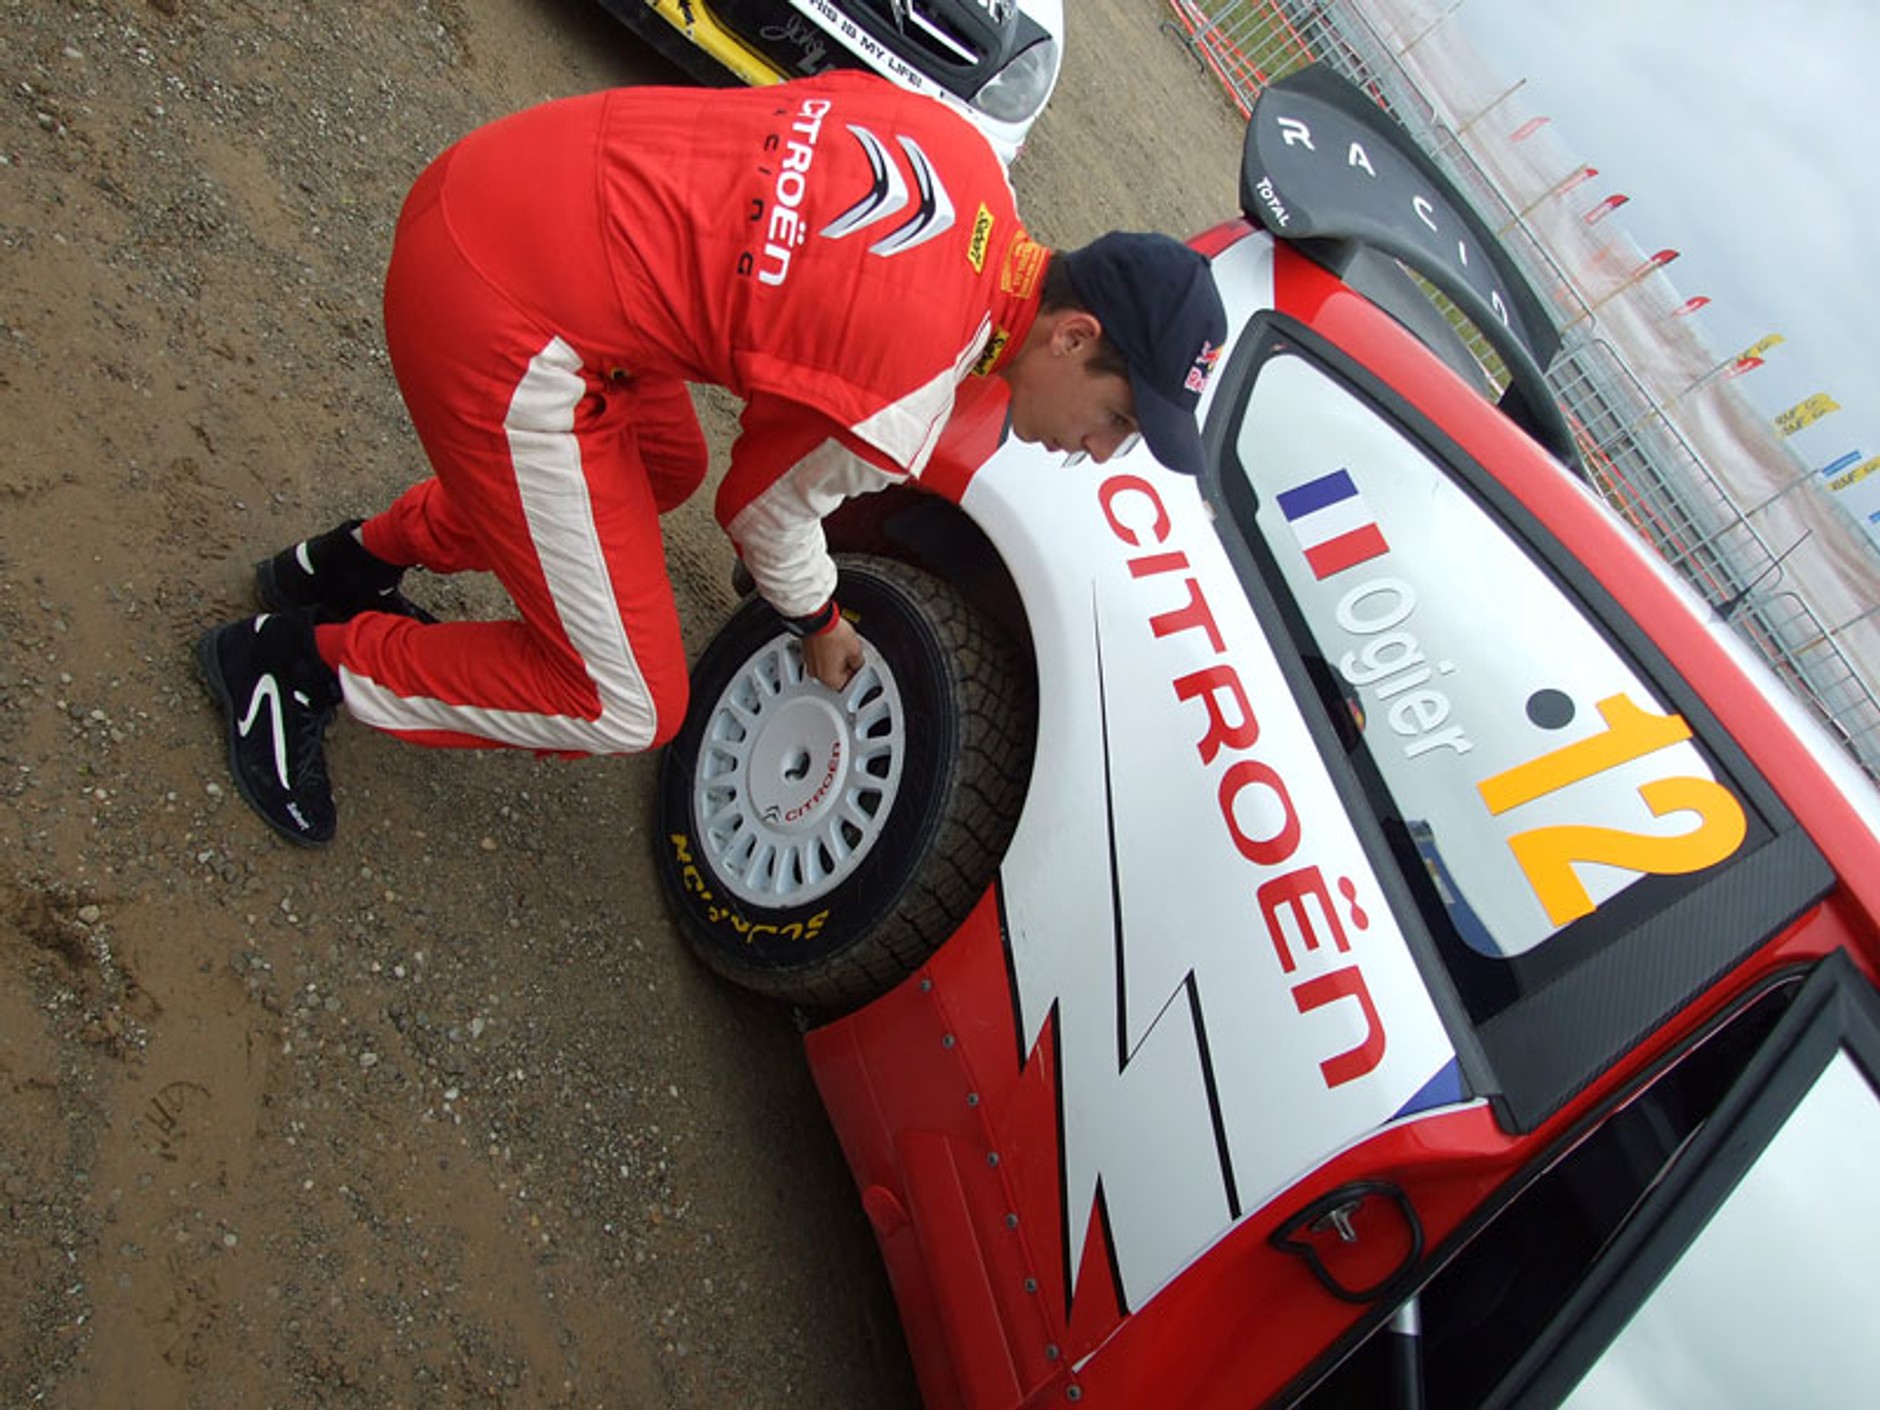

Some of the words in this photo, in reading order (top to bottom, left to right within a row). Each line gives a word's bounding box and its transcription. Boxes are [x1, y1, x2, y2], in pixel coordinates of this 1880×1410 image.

[859, 36, 885, 59] MY
[887, 56, 923, 89] LIFE!
[1254, 176, 1291, 228] TOTAL
[1336, 579, 1475, 762] Ogier
[1476, 692, 1748, 928] 12
